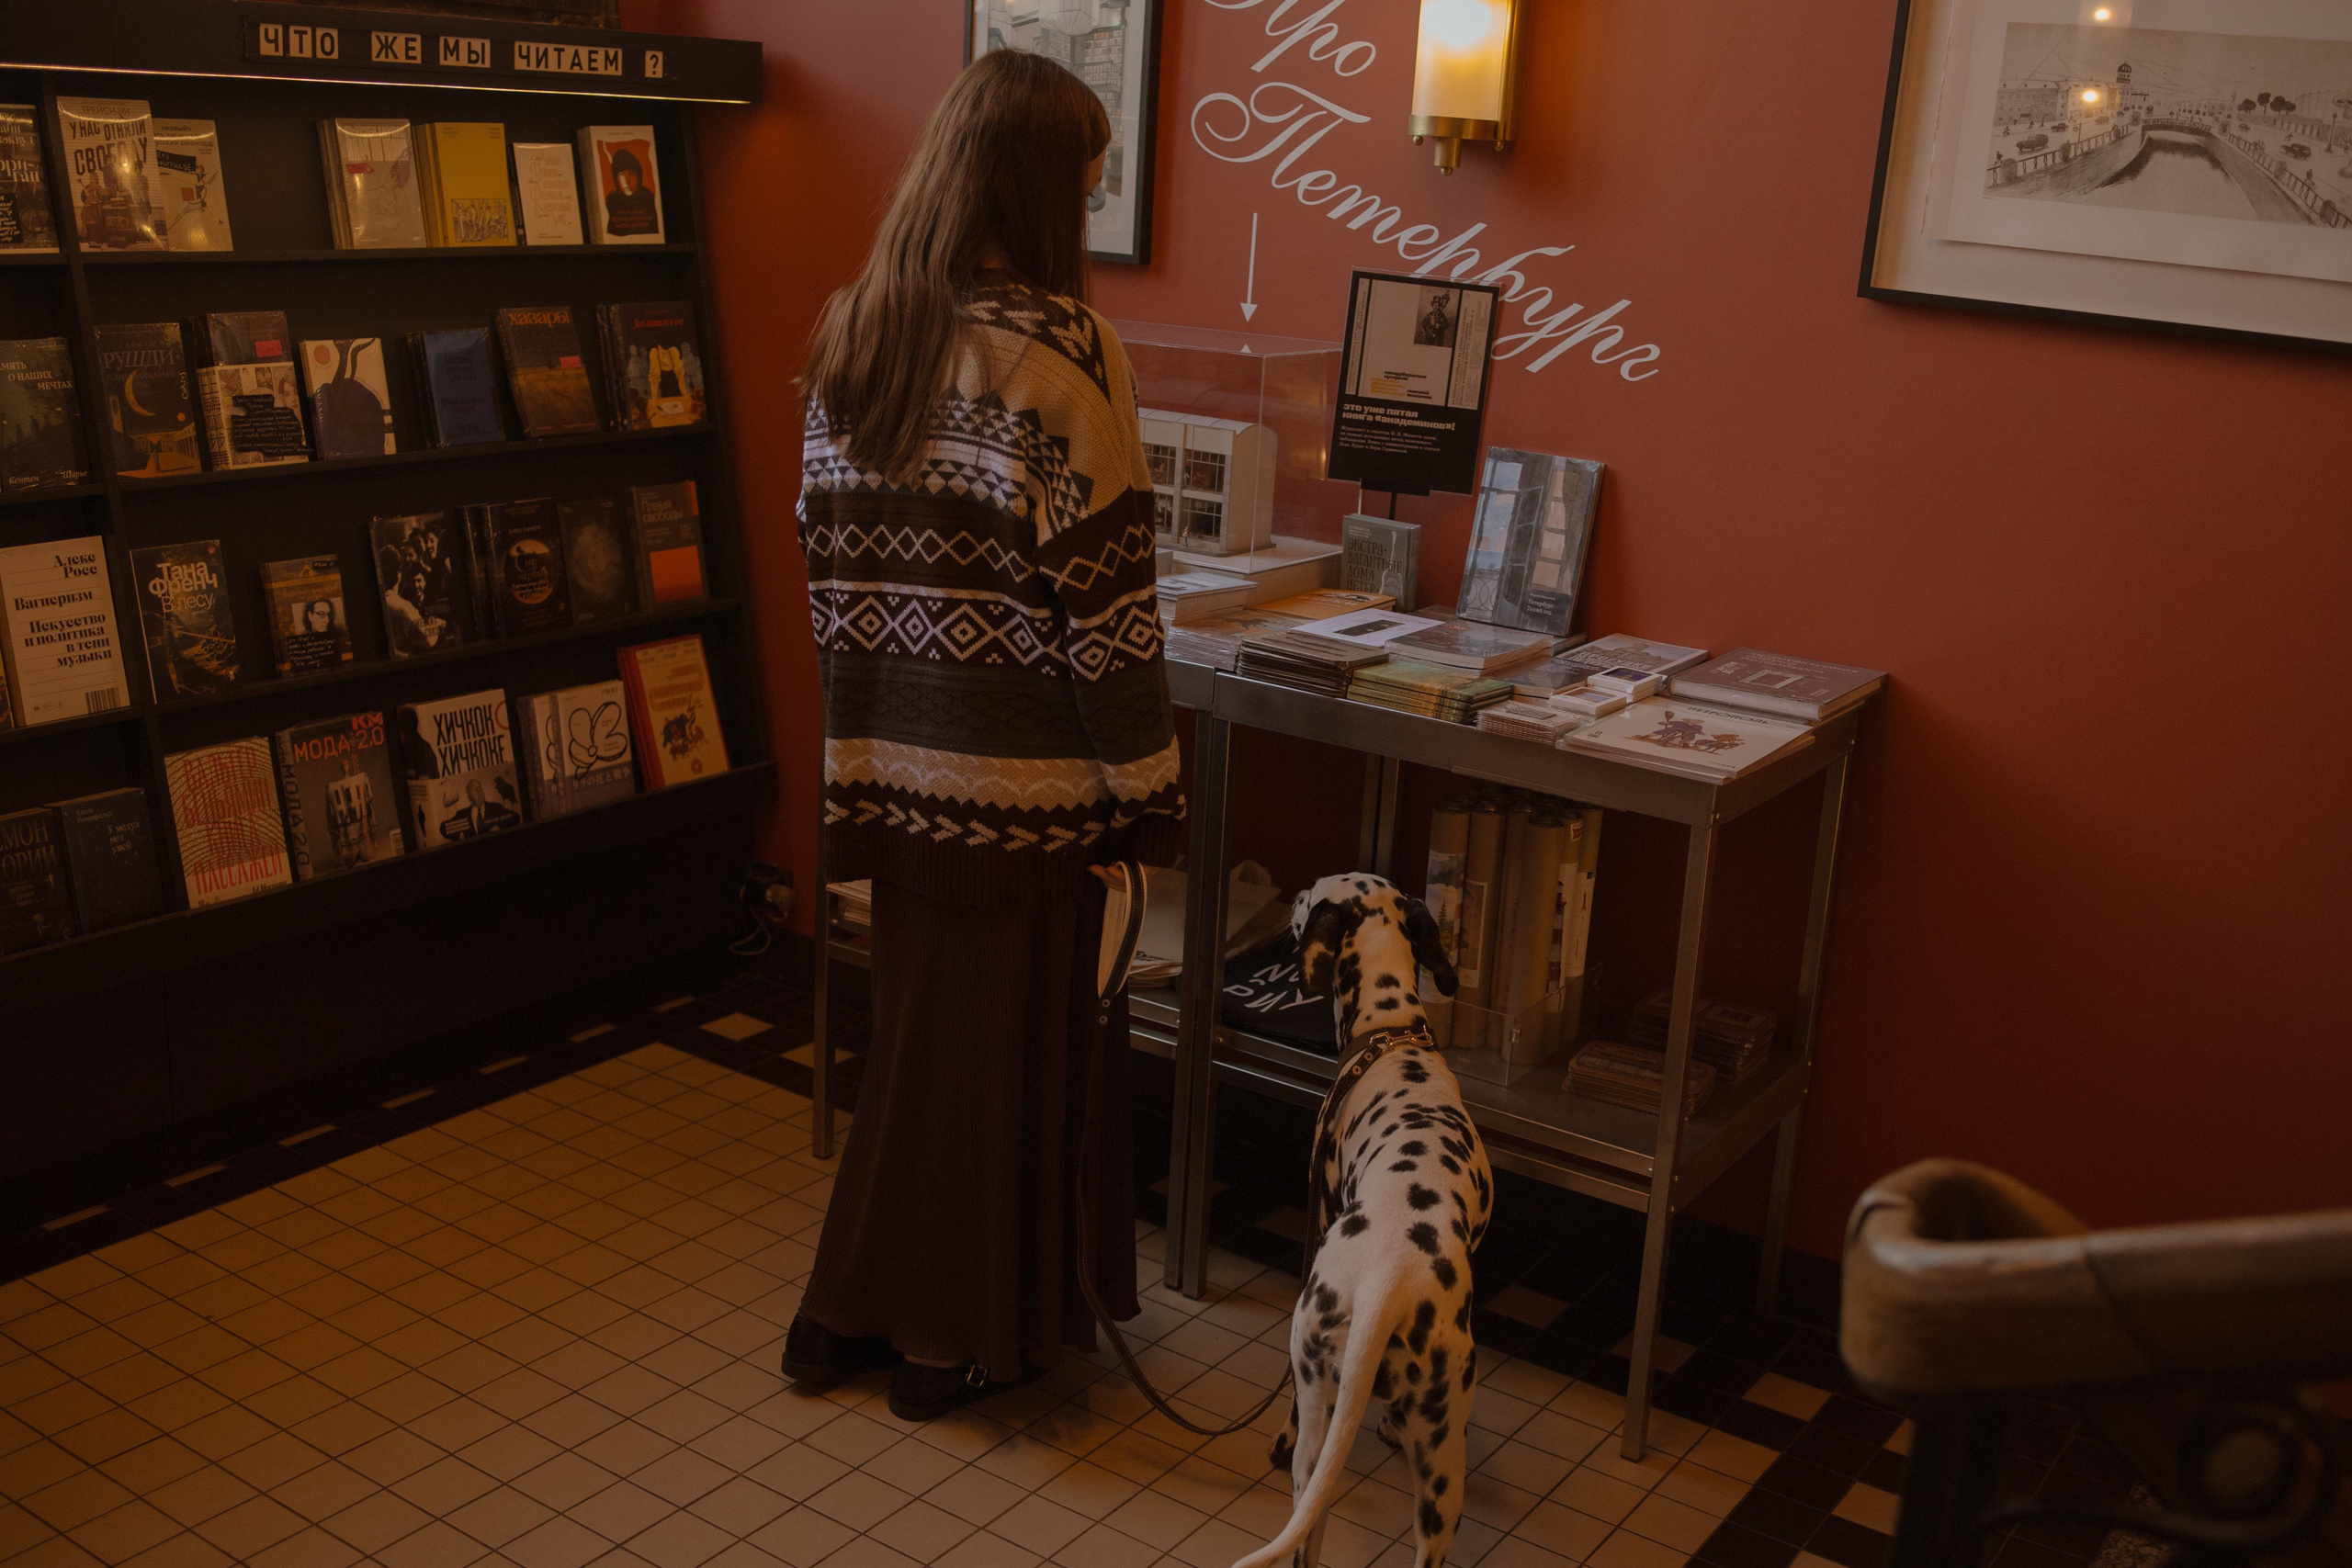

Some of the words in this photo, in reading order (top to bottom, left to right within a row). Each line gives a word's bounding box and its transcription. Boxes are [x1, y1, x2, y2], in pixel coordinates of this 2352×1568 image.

[264, 28, 334, 56] ЧТО
[375, 35, 418, 61] ЖЕ
[444, 39, 484, 65] МЫ
[518, 45, 618, 73] ЧИТАЕМ
[650, 54, 659, 76] ?
[69, 121, 77, 140] У
[79, 121, 100, 138] НАС
[104, 119, 147, 141] ОТНЯЛИ
[103, 348, 176, 371] РУШДИ
[17, 370, 53, 381] НАШИХ
[37, 380, 73, 391] МЕЧТАХ
[1343, 403, 1362, 412] это
[1363, 405, 1385, 414] уже
[1386, 408, 1419, 418] пятая
[54, 553, 96, 569] Алекс
[156, 560, 209, 581] Тана
[63, 566, 97, 580] Росс
[1347, 565, 1374, 582] ДОМА
[148, 573, 219, 599] Френч
[14, 591, 94, 612] Вагнеризм
[176, 592, 214, 610] лесу
[29, 614, 106, 634] Искусство
[24, 637, 35, 648] и
[37, 626, 105, 647] политика
[66, 643, 75, 653] в
[76, 637, 110, 651] тени
[57, 649, 112, 668] музыки
[351, 711, 384, 730] КМ
[433, 704, 495, 747] ХИЧКОК
[1688, 705, 1769, 726] ПЕТРОПОЛЬ
[293, 734, 351, 763] МОДА
[356, 726, 385, 750] 2.0
[438, 734, 504, 778] ХИЧКОКЕ
[281, 764, 306, 828] МОДА
[0, 844, 57, 879] ОРИИ
